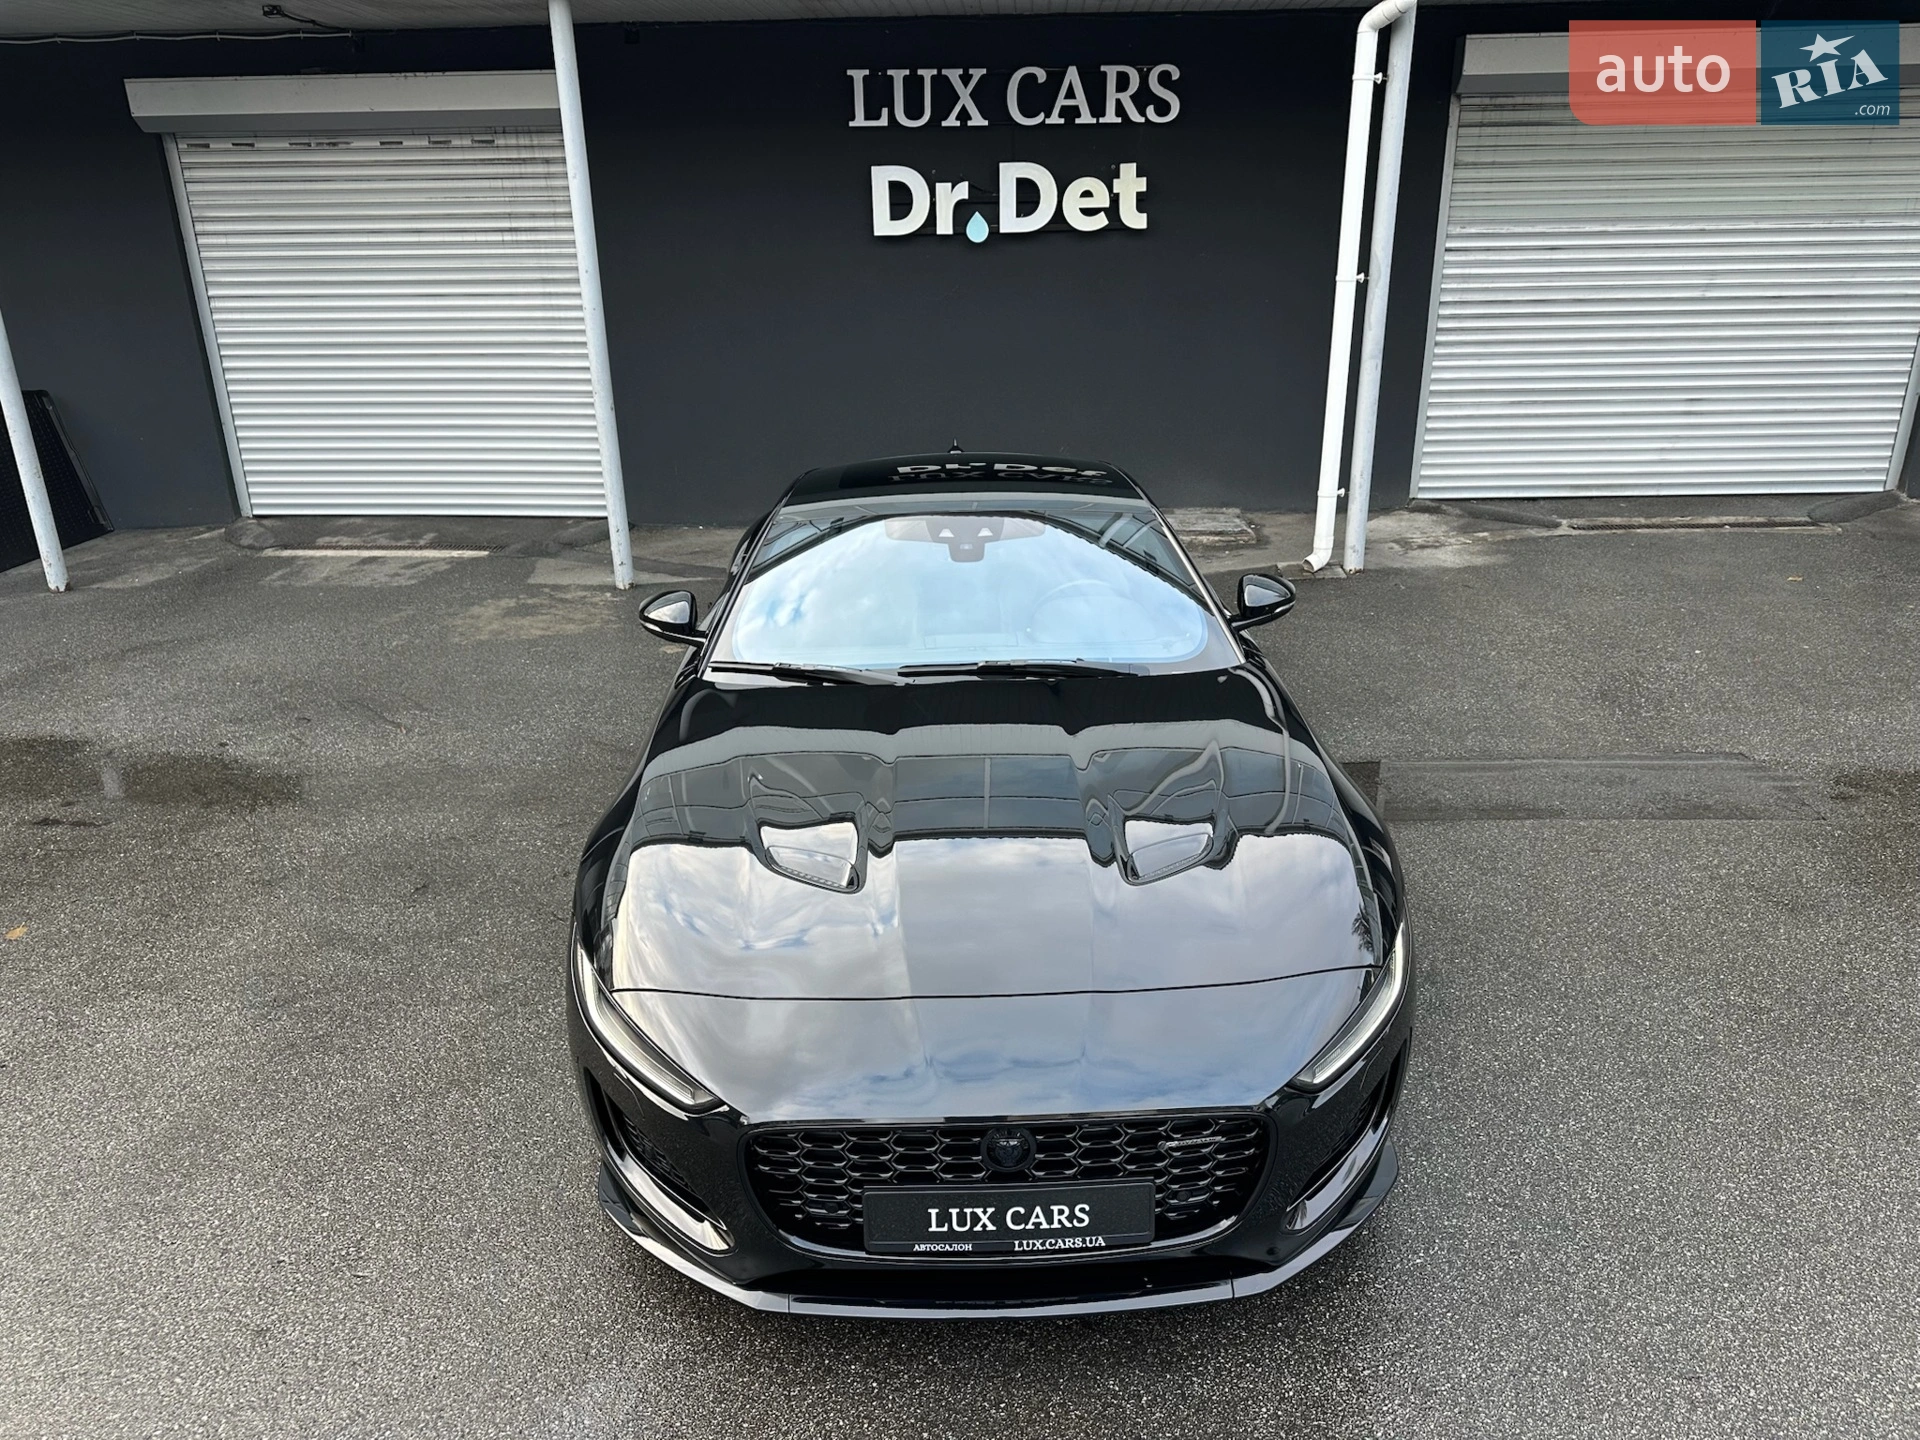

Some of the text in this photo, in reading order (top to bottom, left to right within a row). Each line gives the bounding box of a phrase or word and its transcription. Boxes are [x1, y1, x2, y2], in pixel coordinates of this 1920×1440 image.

[846, 64, 1181, 127] LUX CARS
[927, 1204, 1090, 1232] LUX CARS
[912, 1243, 973, 1252] АВТОСАЛОН
[1013, 1236, 1106, 1251] LUX.CARS.UA
